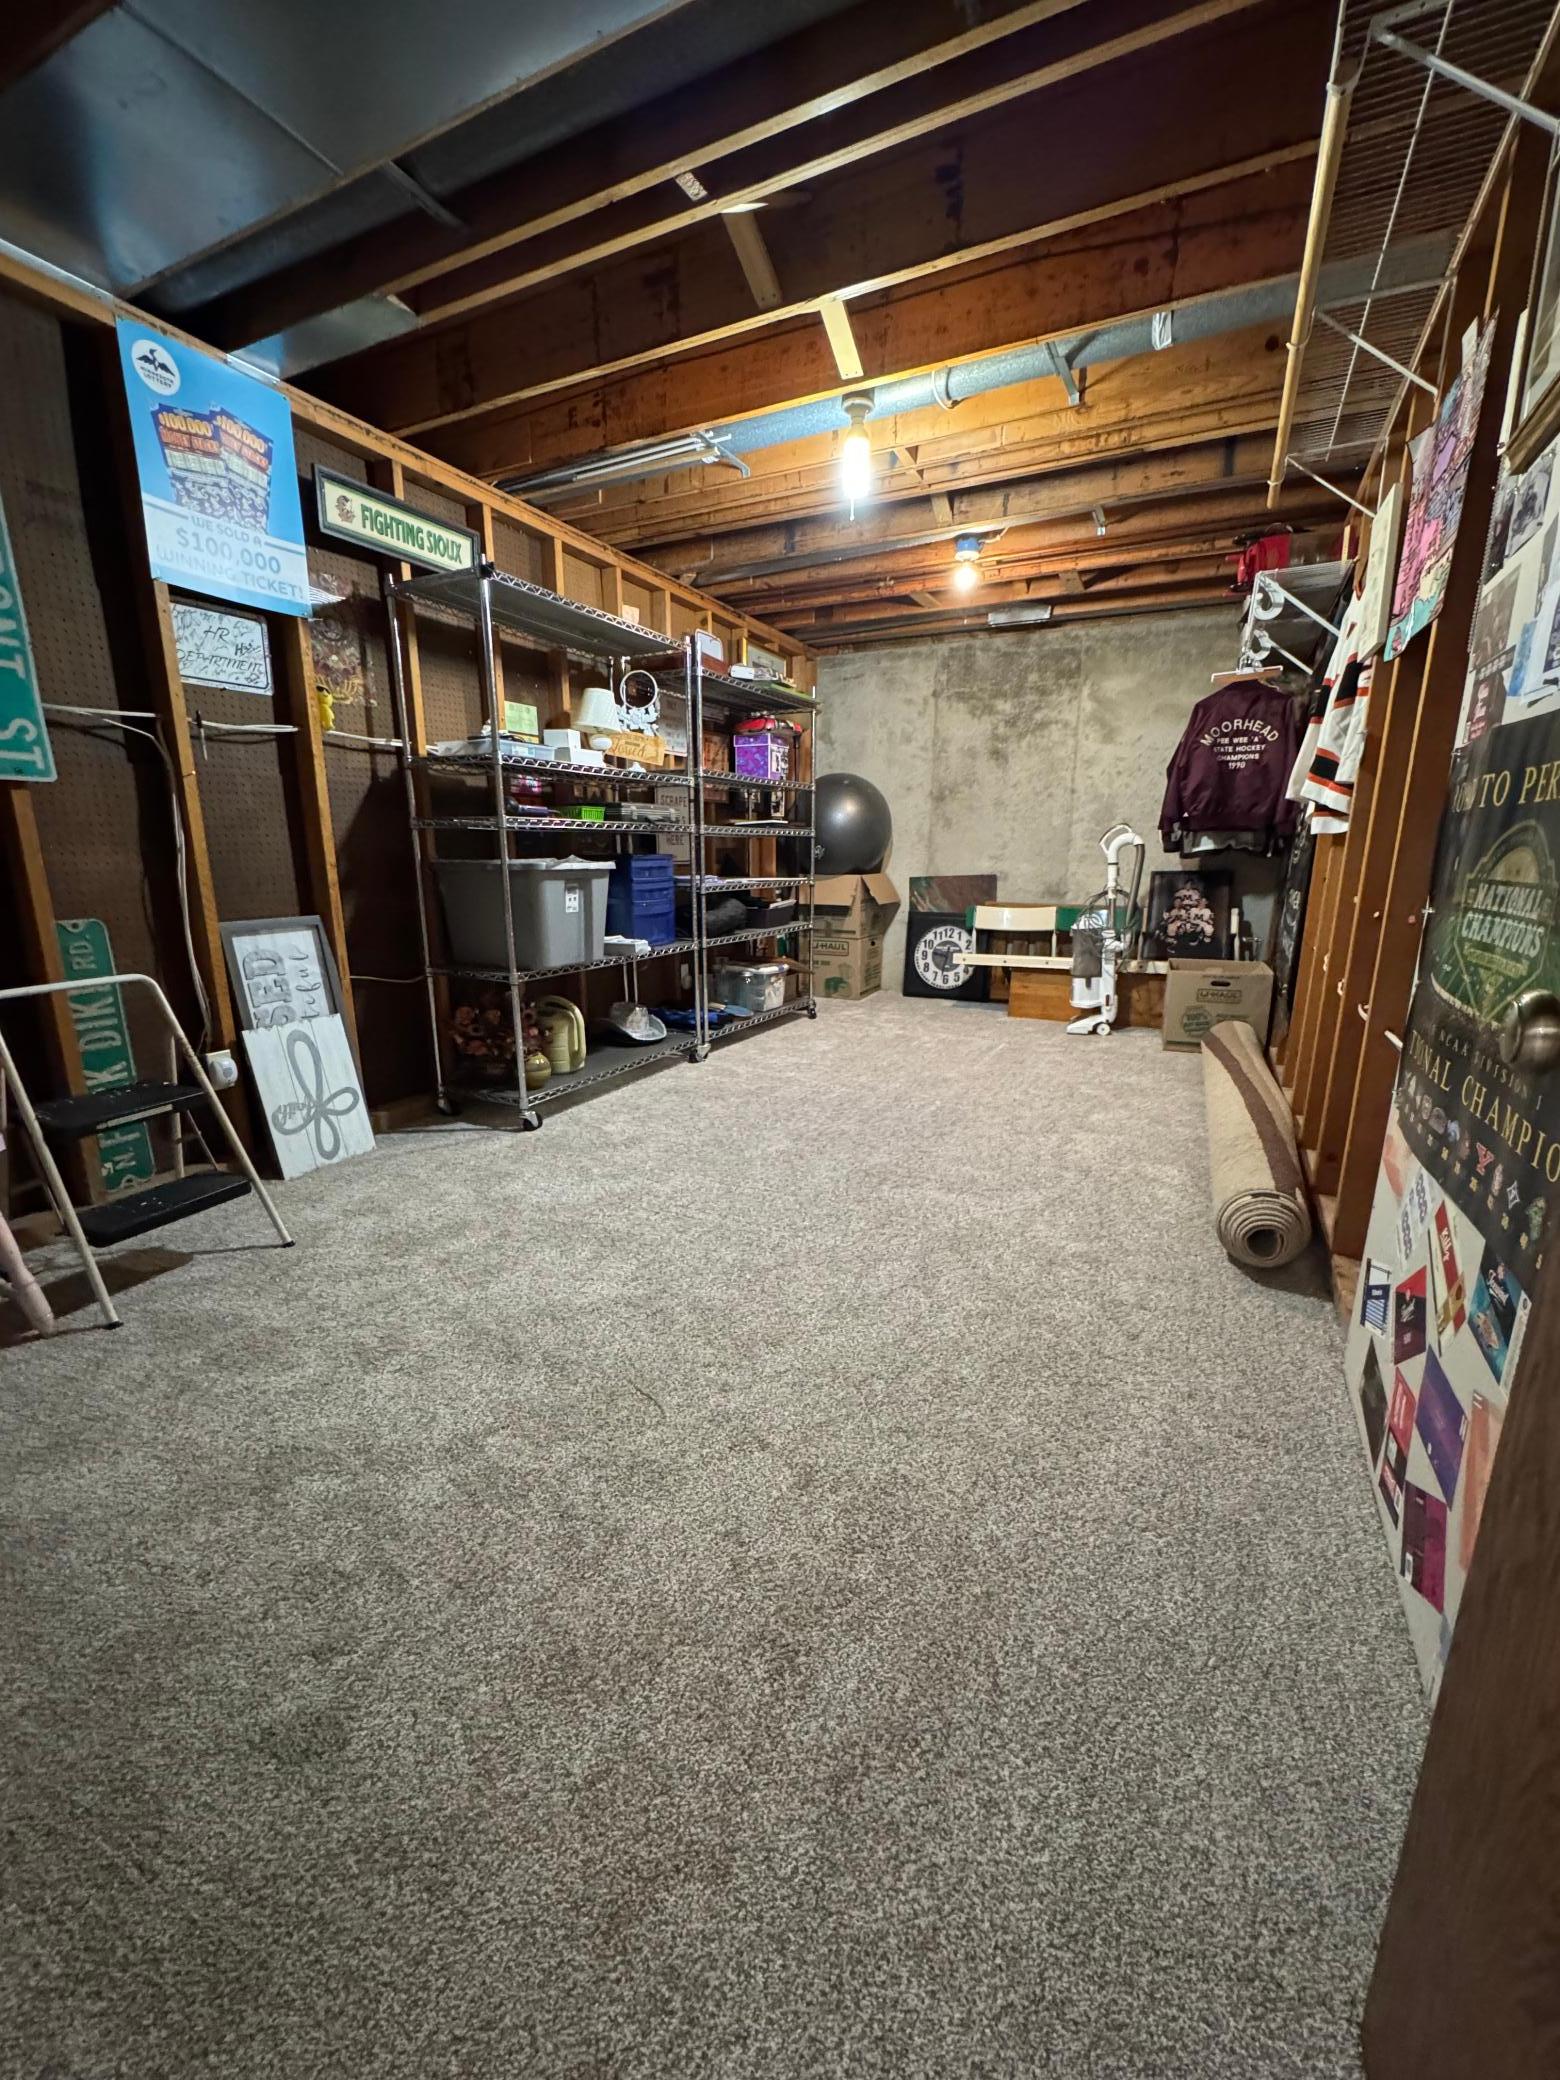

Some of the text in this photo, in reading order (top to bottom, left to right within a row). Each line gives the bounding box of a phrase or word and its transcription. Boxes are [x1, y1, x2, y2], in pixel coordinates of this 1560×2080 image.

[143, 372, 172, 388] LOTTERY
[191, 516, 262, 545] WE SOLD A
[360, 503, 462, 564] FIGHTING SIOUX
[176, 527, 281, 573] $100,000
[156, 545, 304, 599] WINNING TICKET!
[200, 624, 230, 648] HR
[1200, 718, 1279, 746] MOORHEAD
[1236, 744, 1266, 752] HOCKEY
[1228, 761, 1246, 769] 1990
[1479, 770, 1511, 808] TO
[660, 795, 688, 807] SCRAPE
[666, 833, 685, 846] HERE
[1473, 883, 1543, 919] NATIONAL
[933, 931, 943, 940] 11
[943, 928, 955, 938] 12
[957, 931, 962, 941] 1
[1461, 910, 1545, 958] CHAMPIONS
[923, 939, 934, 949] 10
[965, 939, 972, 950] 2
[921, 950, 928, 960] 9
[923, 962, 929, 972] 8
[932, 971, 938, 981] 7
[942, 974, 949, 985] 6
[953, 972, 960, 982] 5
[1200, 991, 1238, 999] U-HAUL
